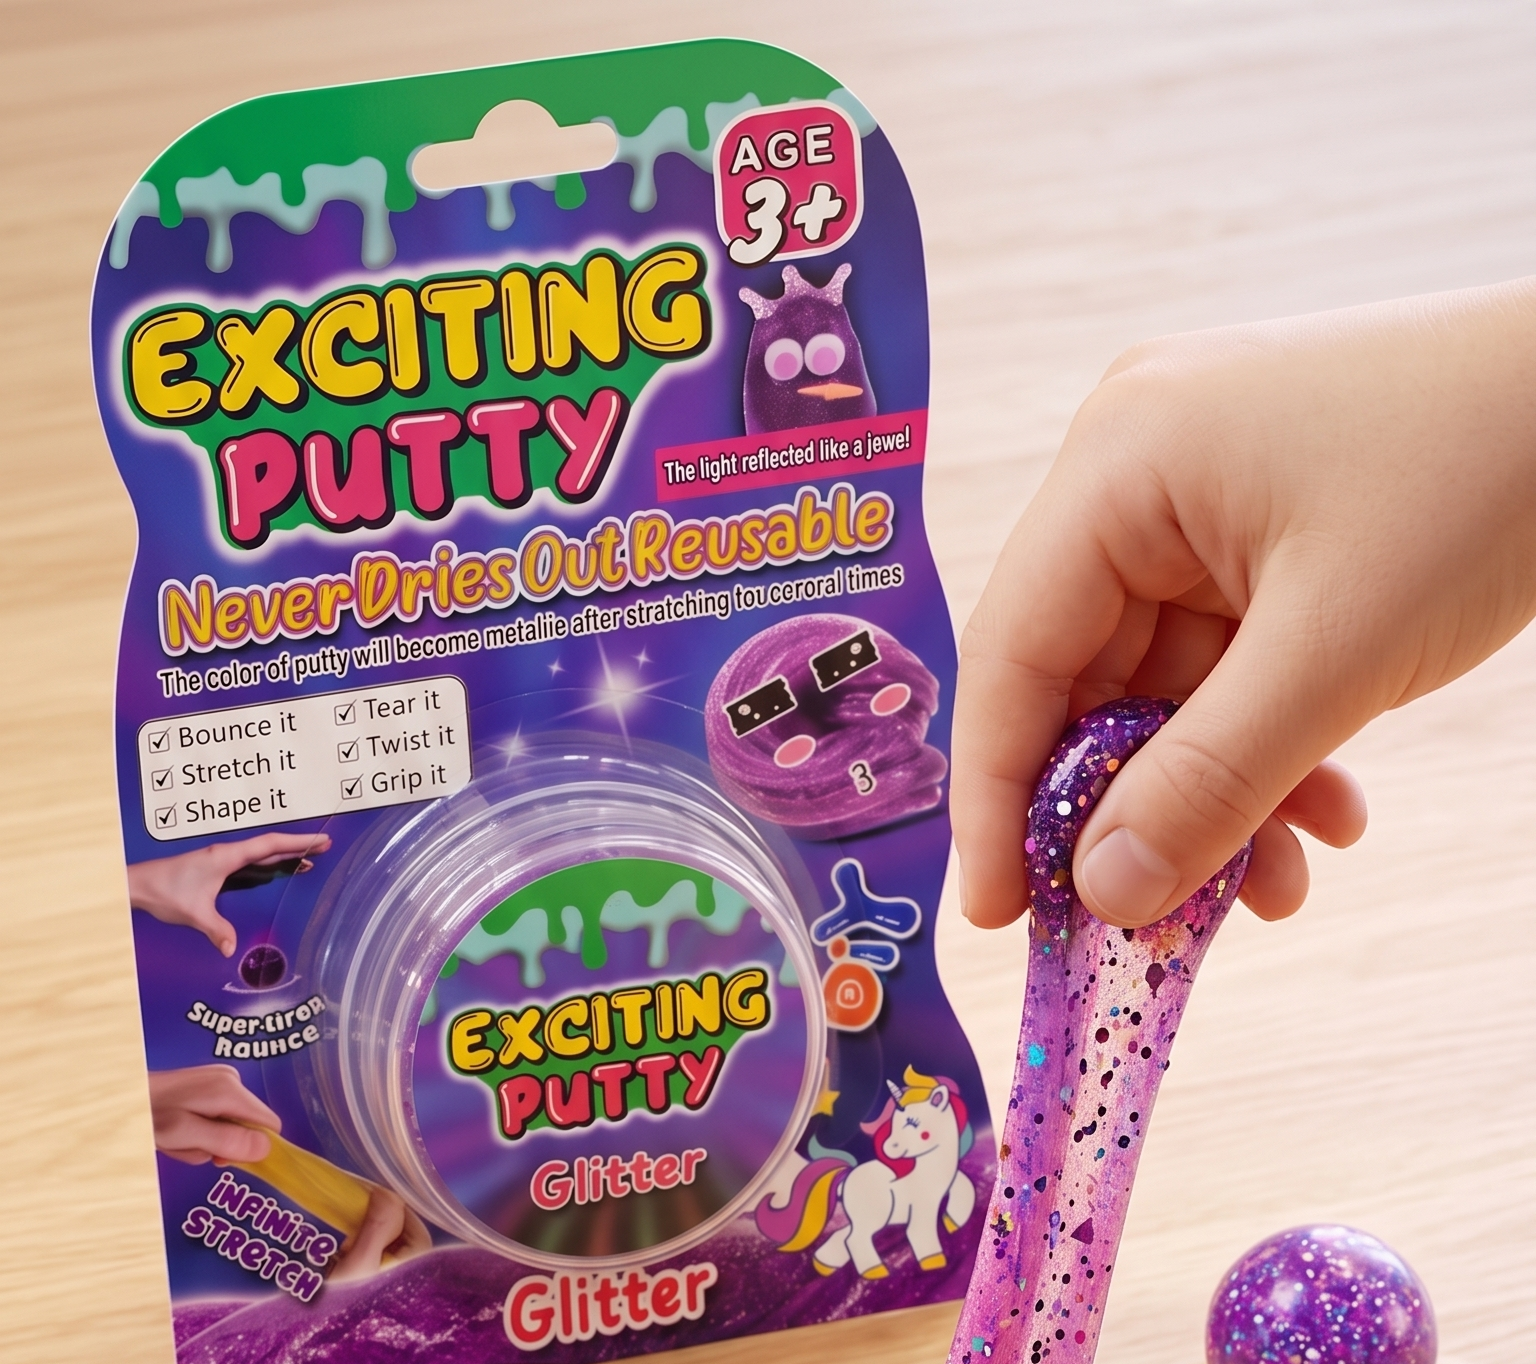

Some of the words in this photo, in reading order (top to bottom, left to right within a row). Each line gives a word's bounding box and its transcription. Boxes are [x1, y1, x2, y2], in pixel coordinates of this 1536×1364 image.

[729, 123, 835, 176] AGE
[727, 176, 847, 269] 3+
[128, 246, 710, 421] EXCITING
[217, 386, 632, 550] PUTTY
[664, 460, 697, 484] The
[699, 451, 738, 483] light
[741, 439, 815, 474] reflected
[818, 435, 849, 463] like
[852, 437, 864, 456] a
[158, 574, 352, 656] Never
[351, 540, 518, 628] Dries
[519, 516, 627, 603] Out
[625, 482, 896, 583] Reusable
[160, 671, 201, 697] The
[206, 660, 262, 690] color
[267, 656, 288, 681] of
[295, 648, 349, 683] putty
[354, 640, 391, 667] will
[396, 630, 480, 663] become
[572, 607, 621, 635] after
[626, 590, 731, 626] stratching
[847, 565, 903, 593] times
[178, 717, 272, 748] Bounce
[279, 711, 298, 734] it
[363, 697, 418, 720] Tear
[424, 689, 442, 711] it
[182, 752, 272, 786] Stretch
[279, 749, 297, 771] it
[366, 730, 432, 758] Twist
[438, 725, 456, 746] it
[185, 797, 262, 824] Shape
[269, 788, 288, 811] it
[371, 768, 423, 795] Grip
[430, 764, 448, 786] it
[450, 970, 770, 1075] EXCITING
[498, 1043, 723, 1140] PUTTY
[530, 1147, 707, 1211] Glitter
[503, 1262, 719, 1351] Glitter
